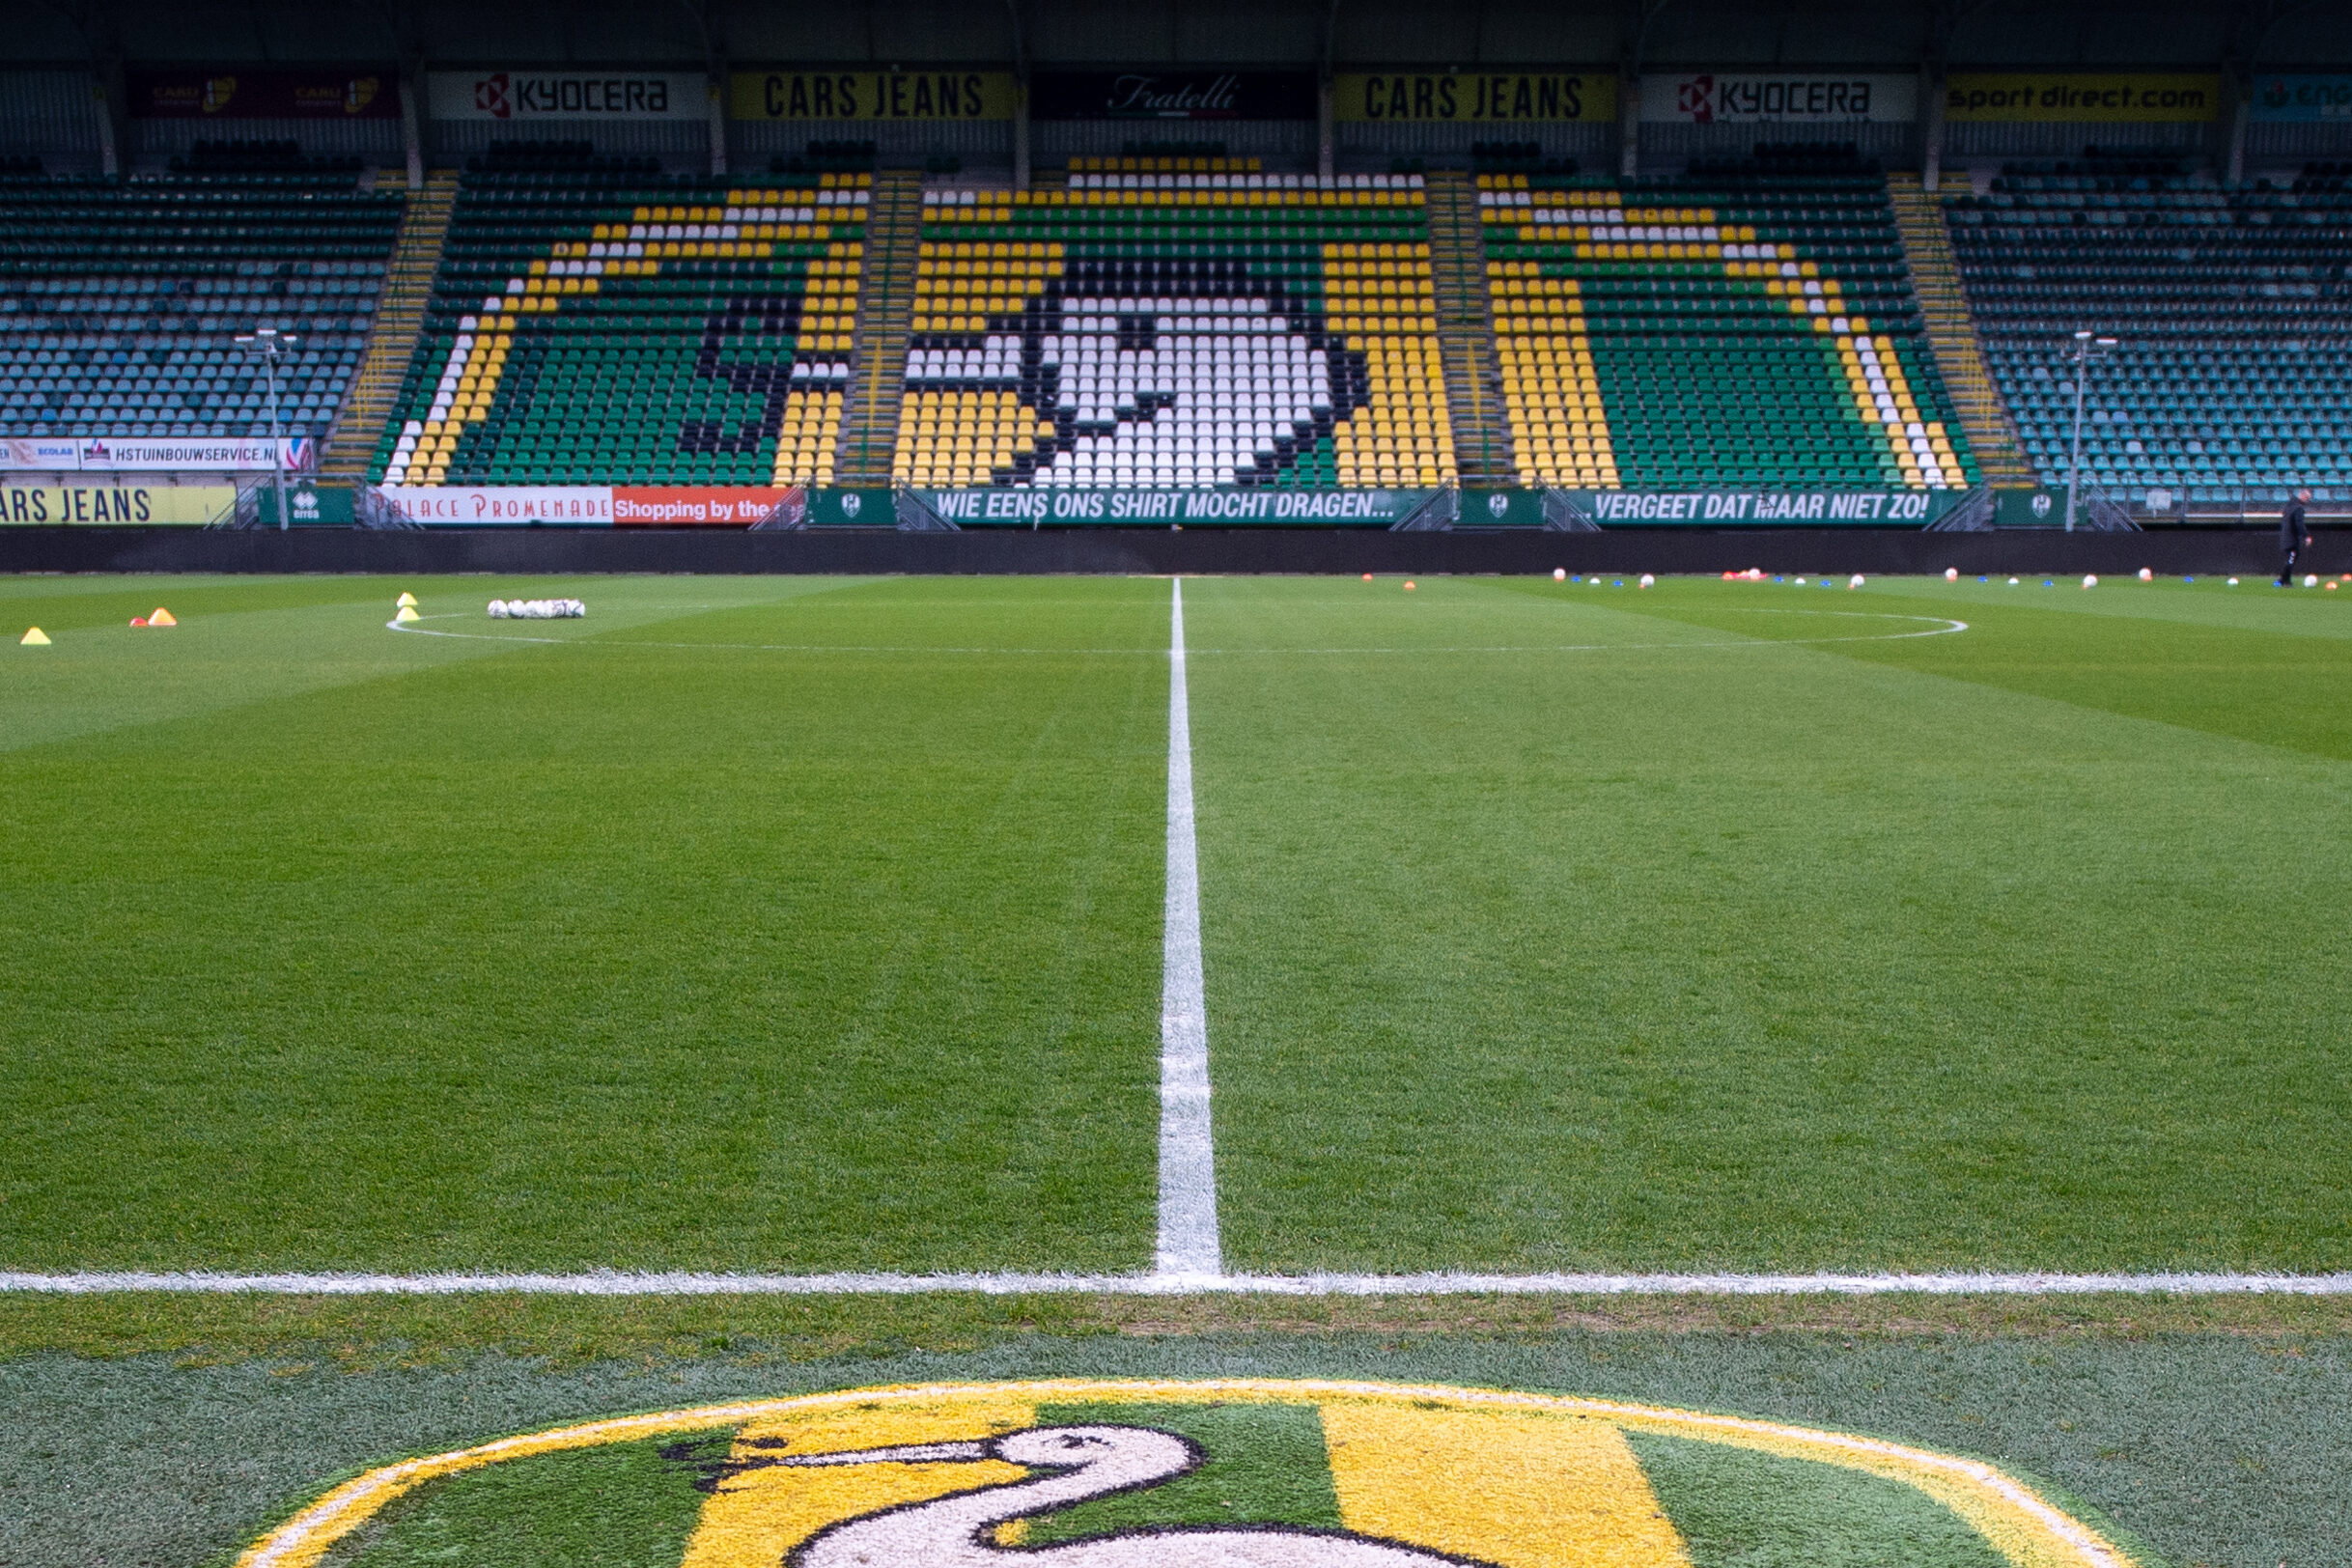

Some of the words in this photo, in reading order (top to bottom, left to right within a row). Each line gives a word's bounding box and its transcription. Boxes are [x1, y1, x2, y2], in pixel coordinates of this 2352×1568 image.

[517, 80, 667, 112] KYOCERA
[765, 75, 856, 117] CARS
[874, 75, 982, 117] JEANS
[1106, 74, 1242, 109] Fratelli
[1365, 77, 1456, 118] CARS
[1472, 77, 1582, 118] JEANS
[1720, 82, 1869, 113] KYOCERA
[62, 489, 150, 522] JEANS
[370, 493, 459, 518] PALACE
[470, 494, 608, 518] PROMENADE
[615, 500, 706, 519] Shopping
[711, 500, 733, 520] by
[738, 500, 770, 518] the
[937, 492, 981, 518] WIE
[986, 492, 1048, 518] EENS
[1054, 492, 1104, 518] ONS
[1110, 492, 1183, 518] SHIRT
[1185, 492, 1273, 518] MOCHT
[1275, 492, 1393, 518] DRAGEN...
[1704, 493, 1751, 518] DAT
[1753, 493, 1825, 518] MAAR
[1829, 493, 1887, 518] NIET
[1888, 493, 1930, 518] ZO!
